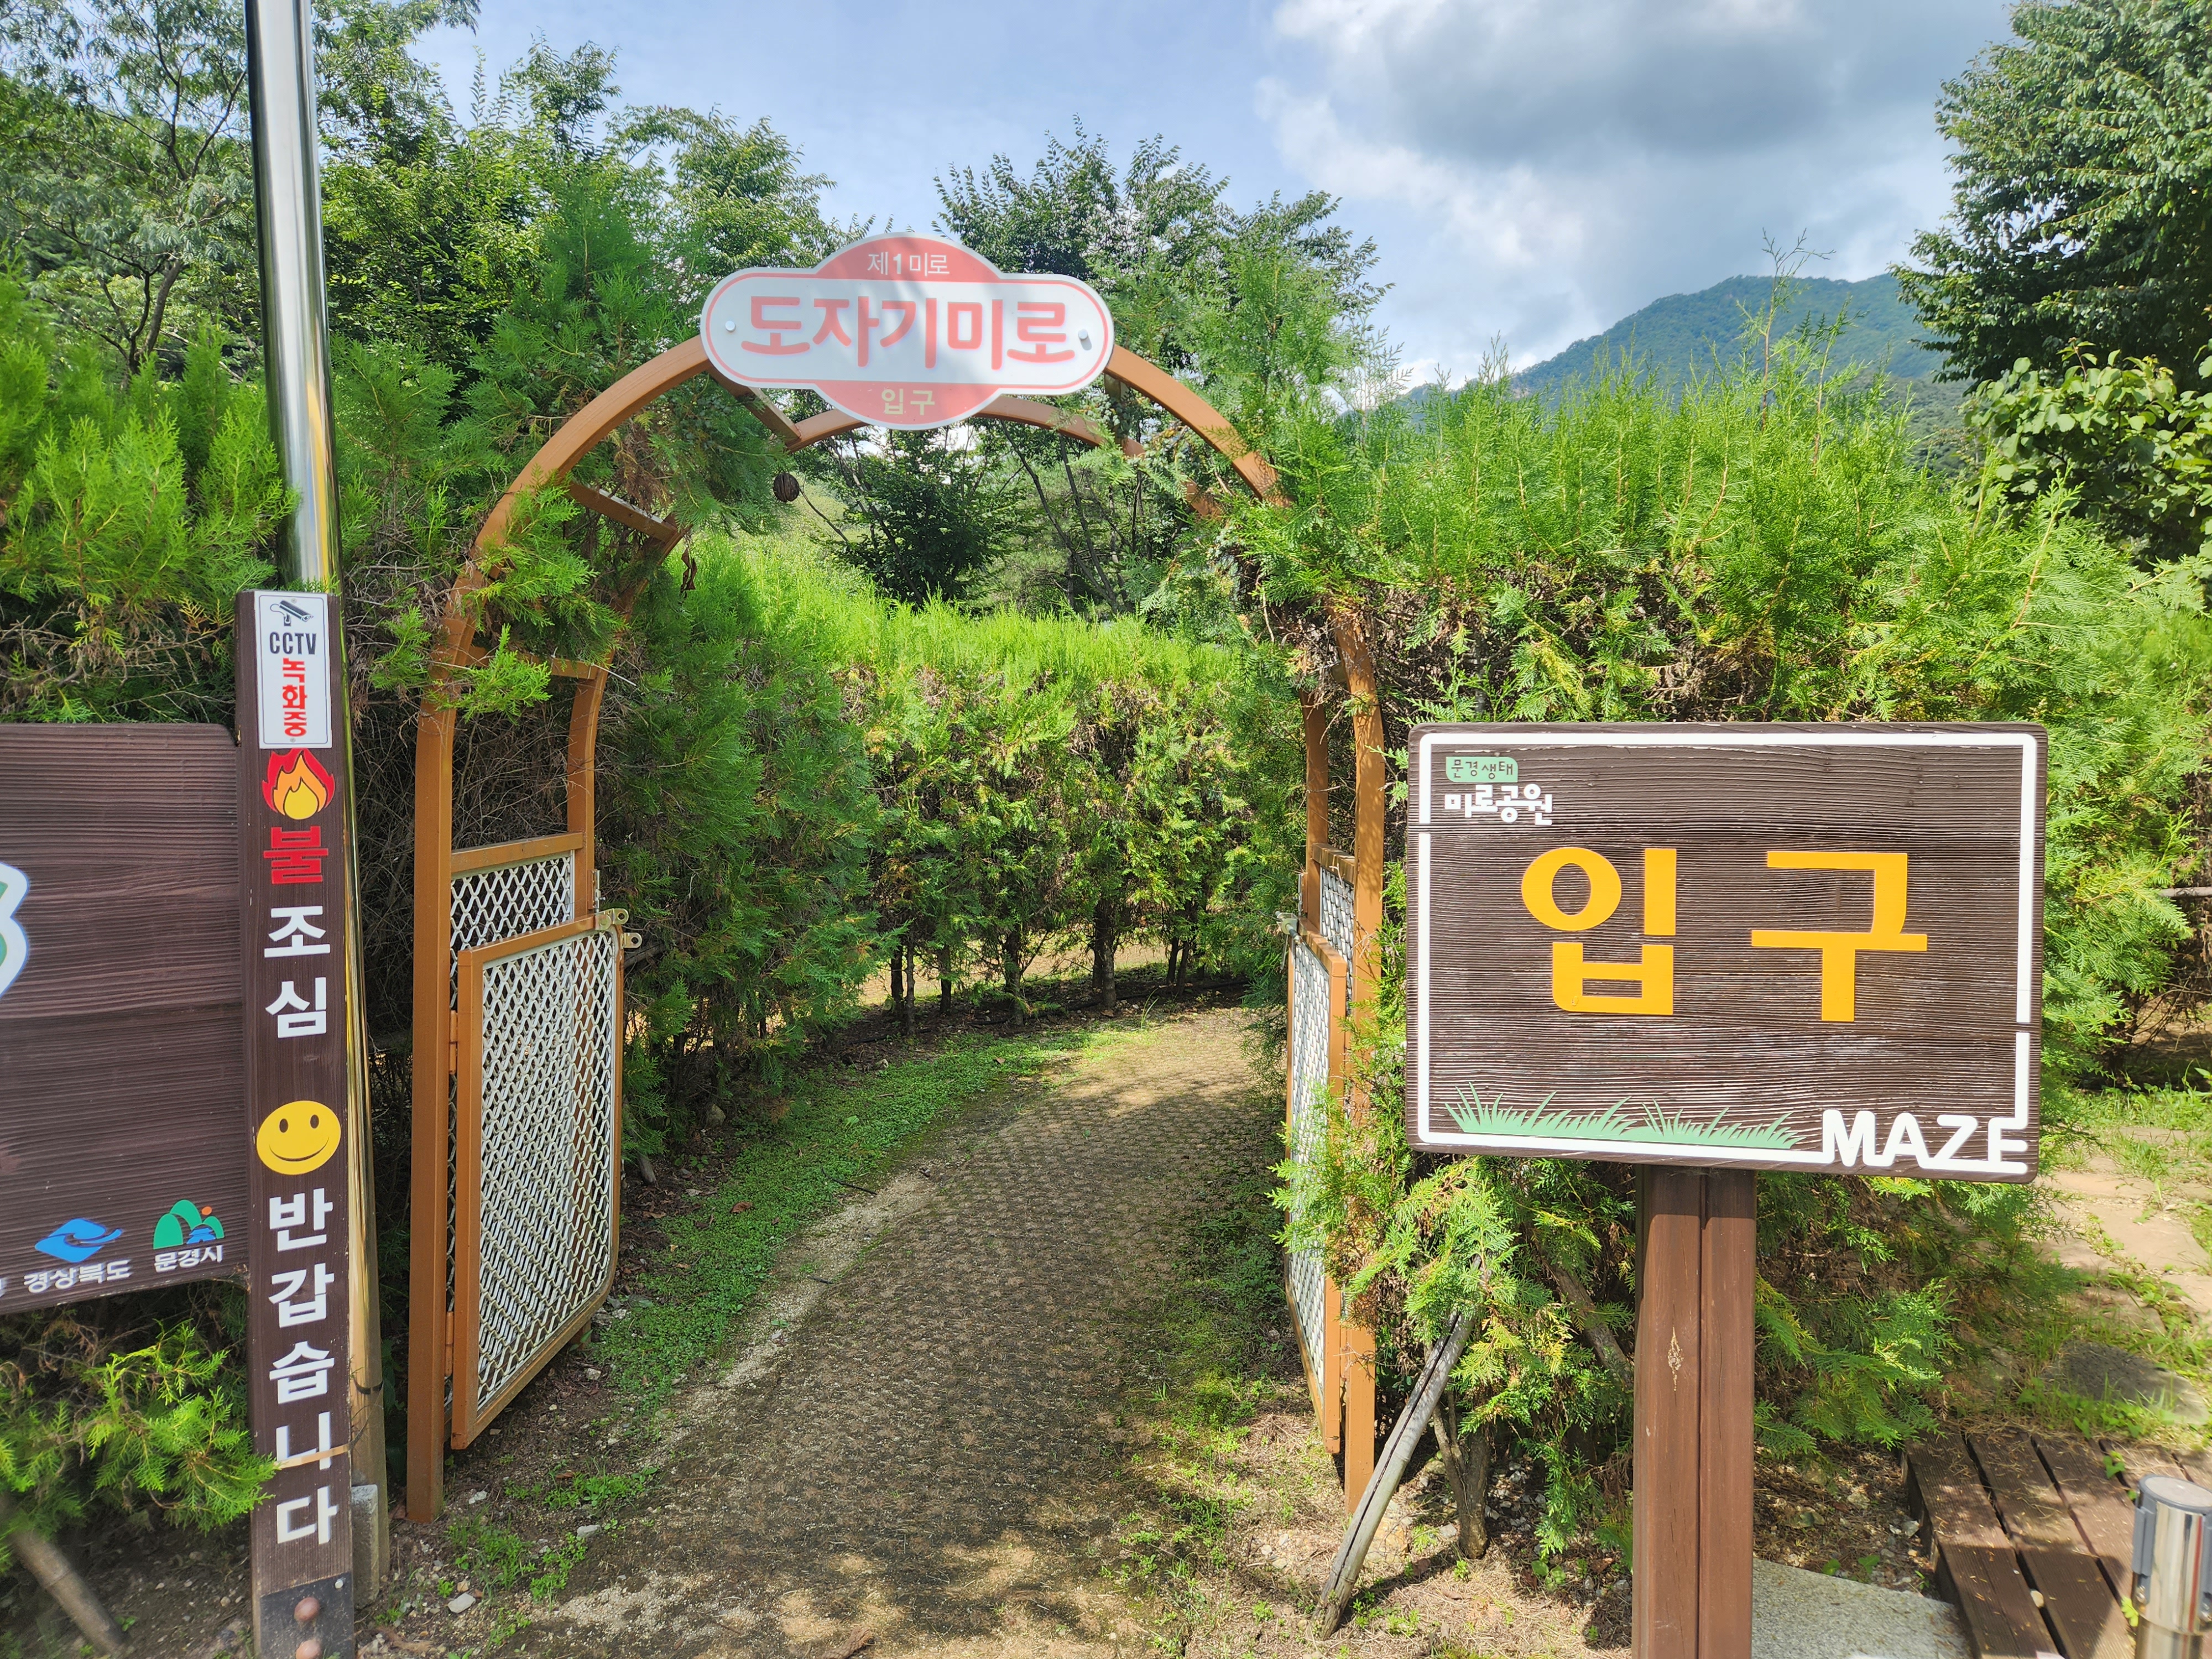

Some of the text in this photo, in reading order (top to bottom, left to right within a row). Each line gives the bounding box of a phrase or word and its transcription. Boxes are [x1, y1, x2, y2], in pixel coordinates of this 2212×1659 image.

[741, 296, 1075, 370] 도자기미로
[881, 388, 935, 415] 입구
[269, 632, 316, 655] CCTV
[282, 658, 307, 737] 녹화중
[1451, 758, 1514, 780] 문경생태
[1444, 783, 1553, 826] 미로공원
[1521, 847, 1928, 1022] 입구
[1823, 1109, 2028, 1175] MAZE
[23, 1259, 132, 1293] 경상북도
[154, 1245, 223, 1272] 문경시
[269, 1188, 338, 1545] 반갑습니다
